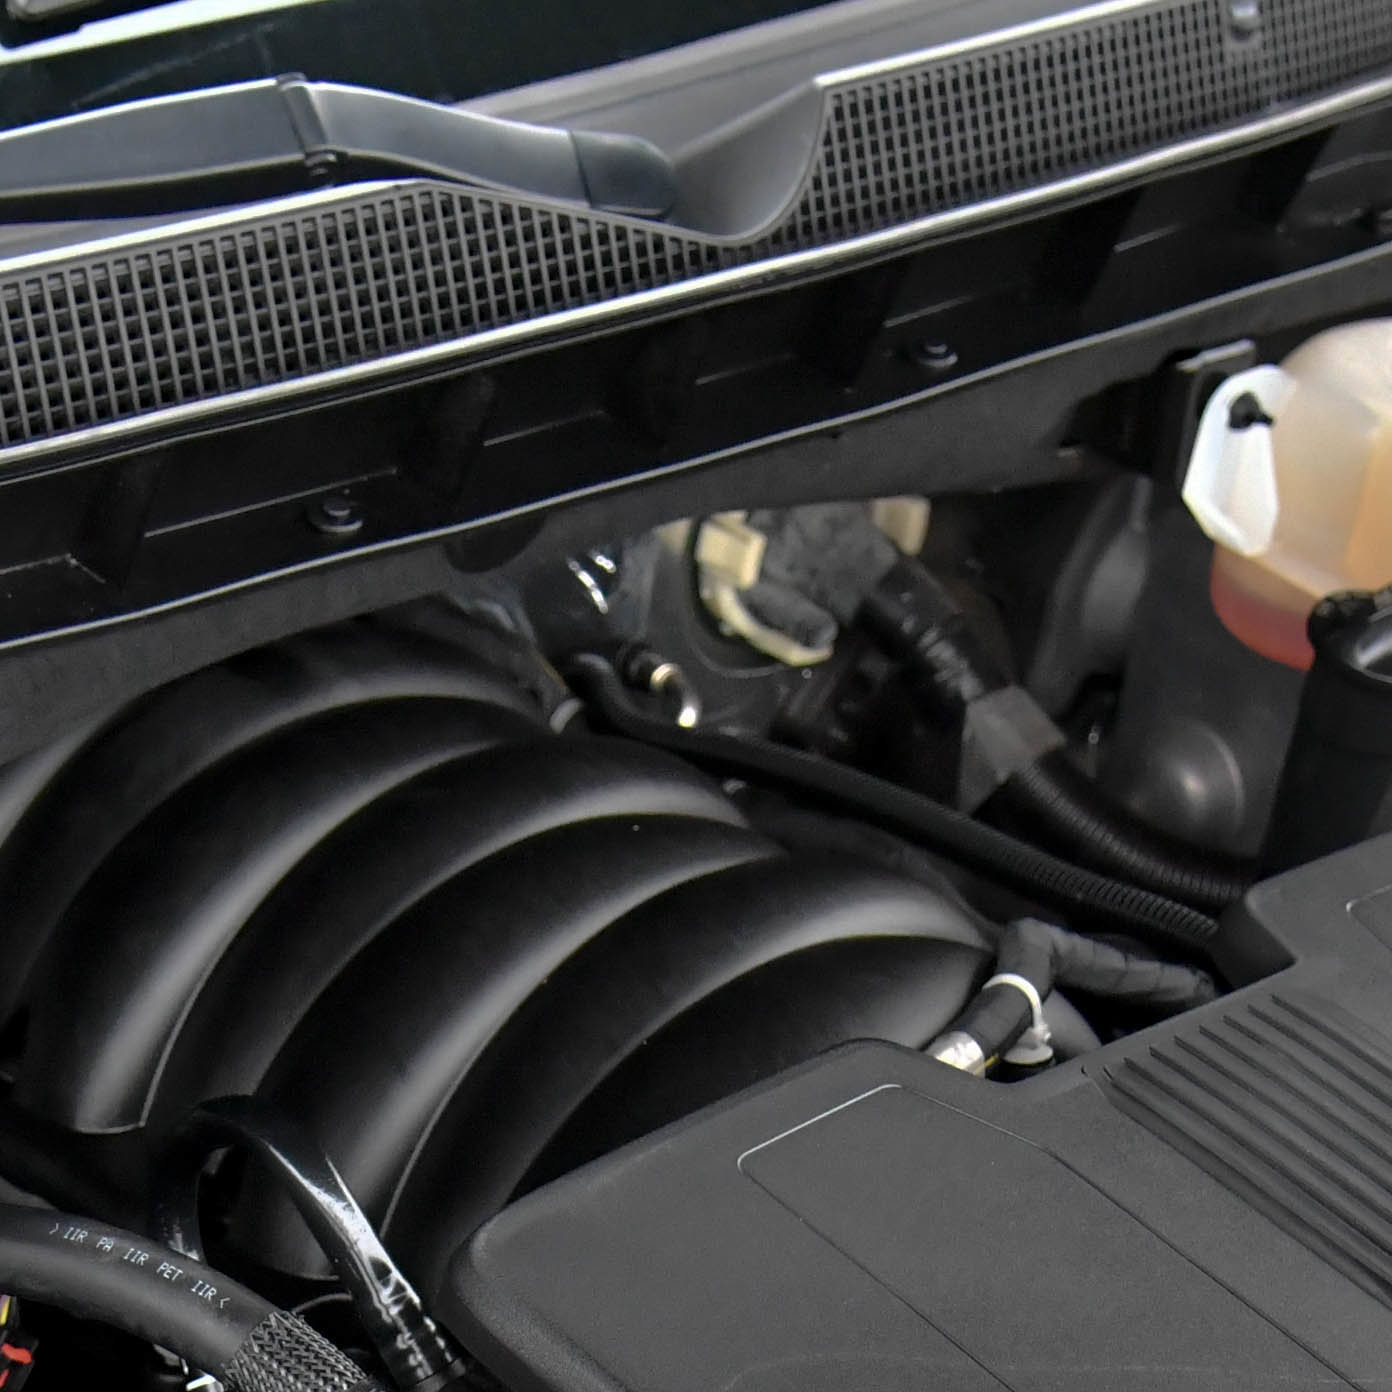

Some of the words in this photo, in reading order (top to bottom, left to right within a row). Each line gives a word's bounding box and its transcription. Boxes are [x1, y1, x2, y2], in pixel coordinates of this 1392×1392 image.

[96, 1236, 115, 1252] PA
[122, 1247, 150, 1266] IIR
[157, 1262, 183, 1281] PET
